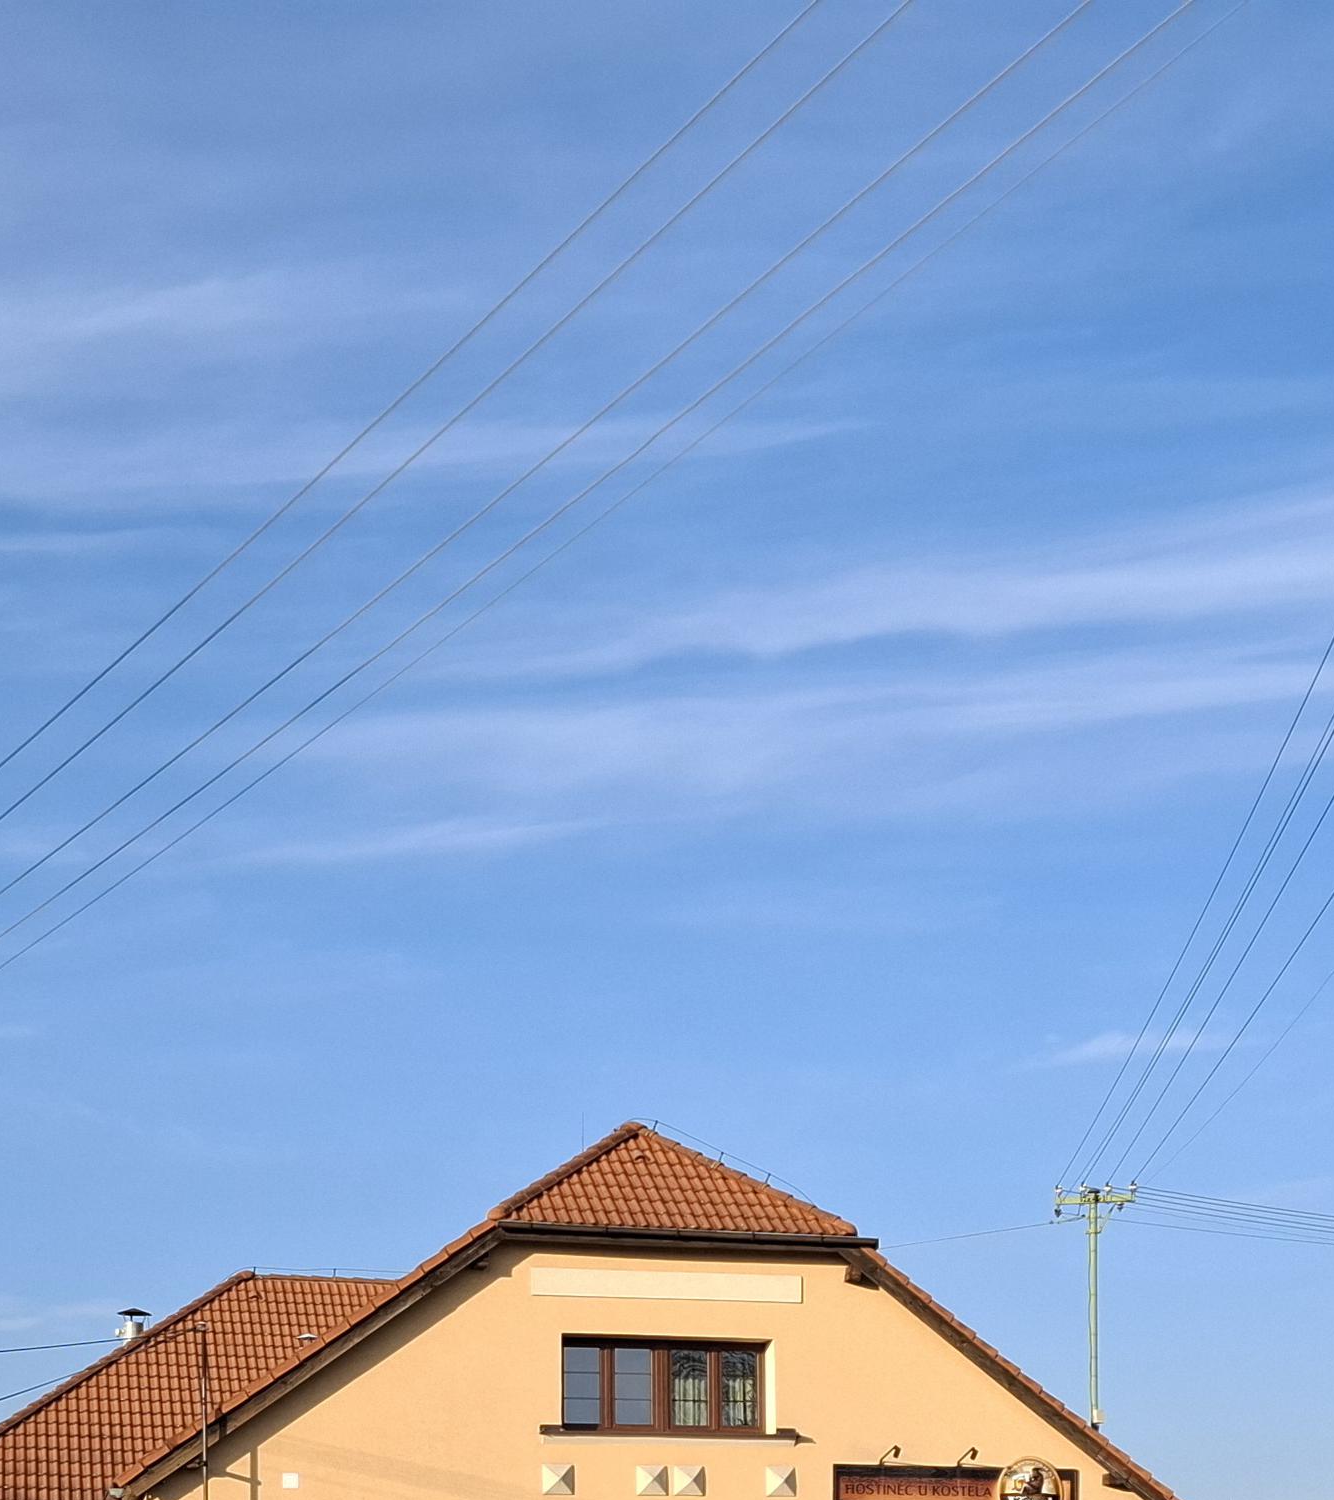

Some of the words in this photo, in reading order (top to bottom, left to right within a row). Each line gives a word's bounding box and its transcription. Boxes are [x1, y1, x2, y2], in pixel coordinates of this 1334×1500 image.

[845, 1482, 914, 1497] HOSTINEC
[918, 1485, 928, 1496] U
[932, 1485, 992, 1497] KOSTELA
